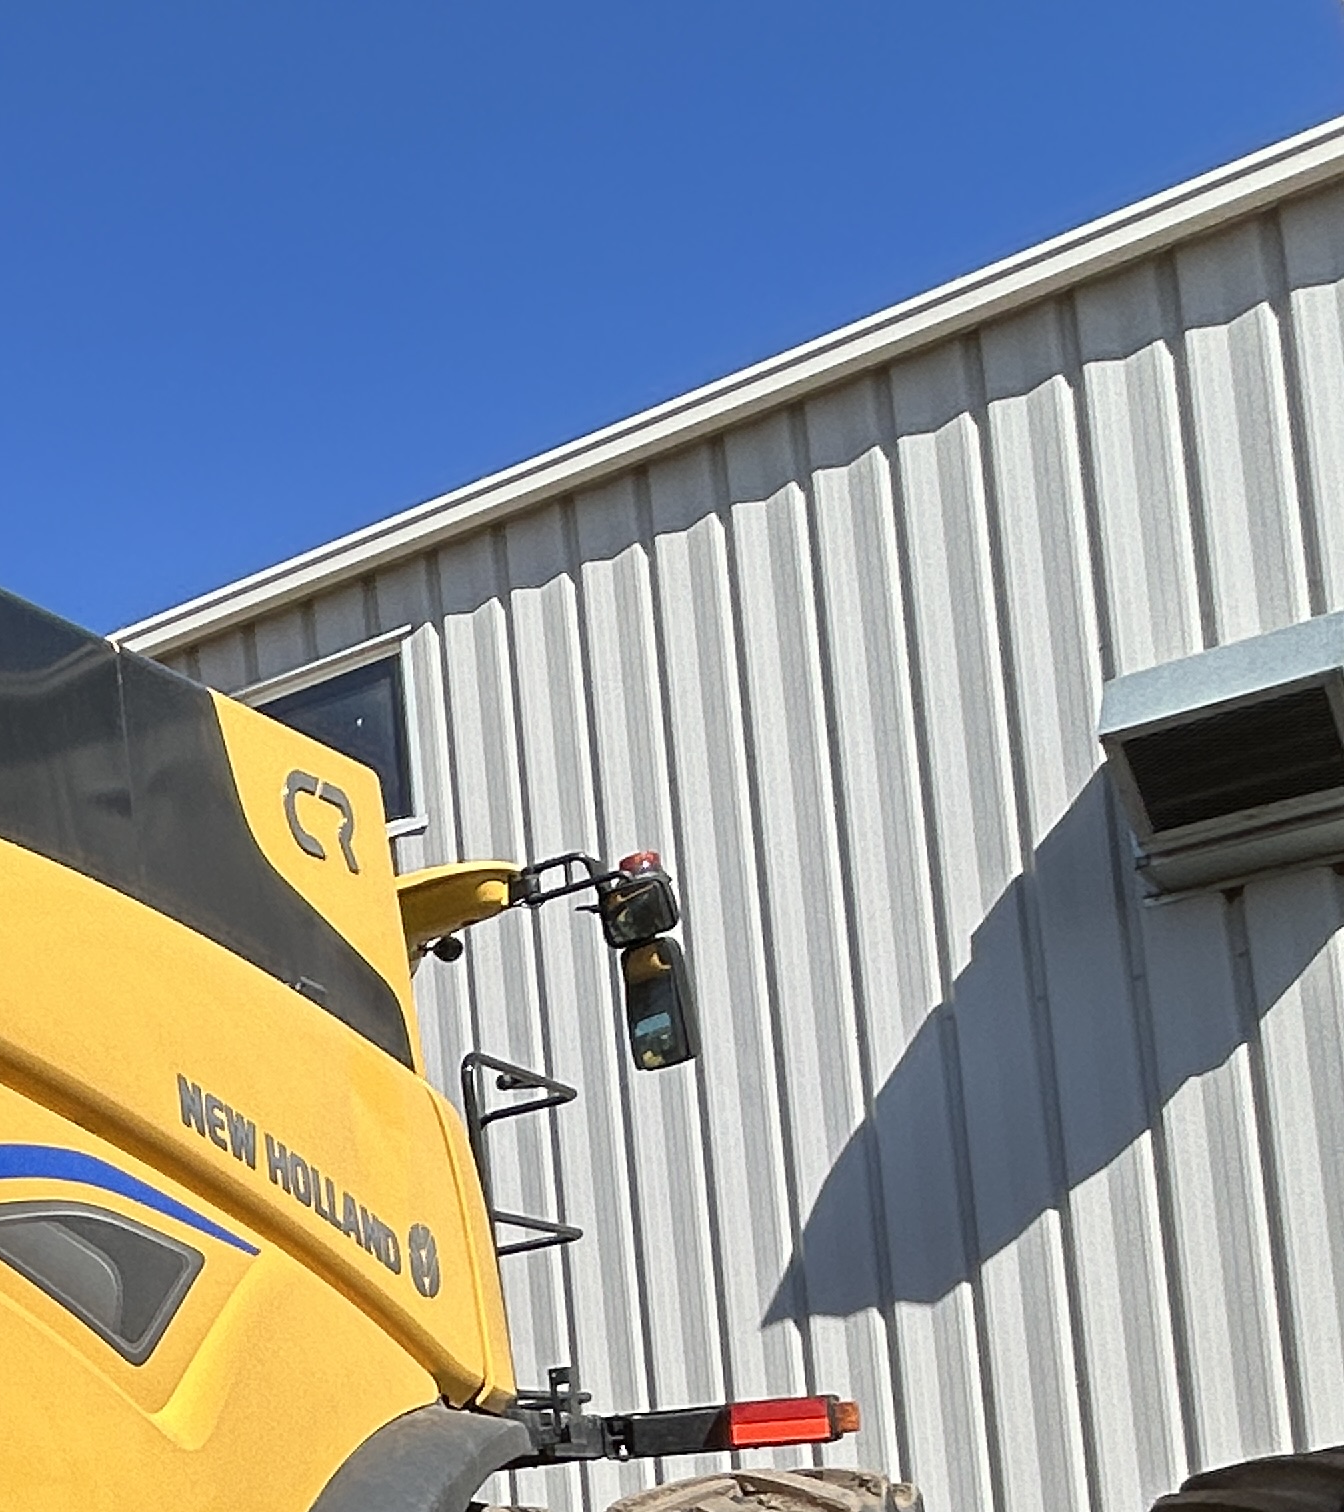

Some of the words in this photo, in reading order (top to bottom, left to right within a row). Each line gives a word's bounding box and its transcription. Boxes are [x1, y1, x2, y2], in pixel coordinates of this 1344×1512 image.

[283, 769, 359, 875] CR
[177, 1073, 256, 1170] NEW
[264, 1133, 402, 1275] HOLLAND
